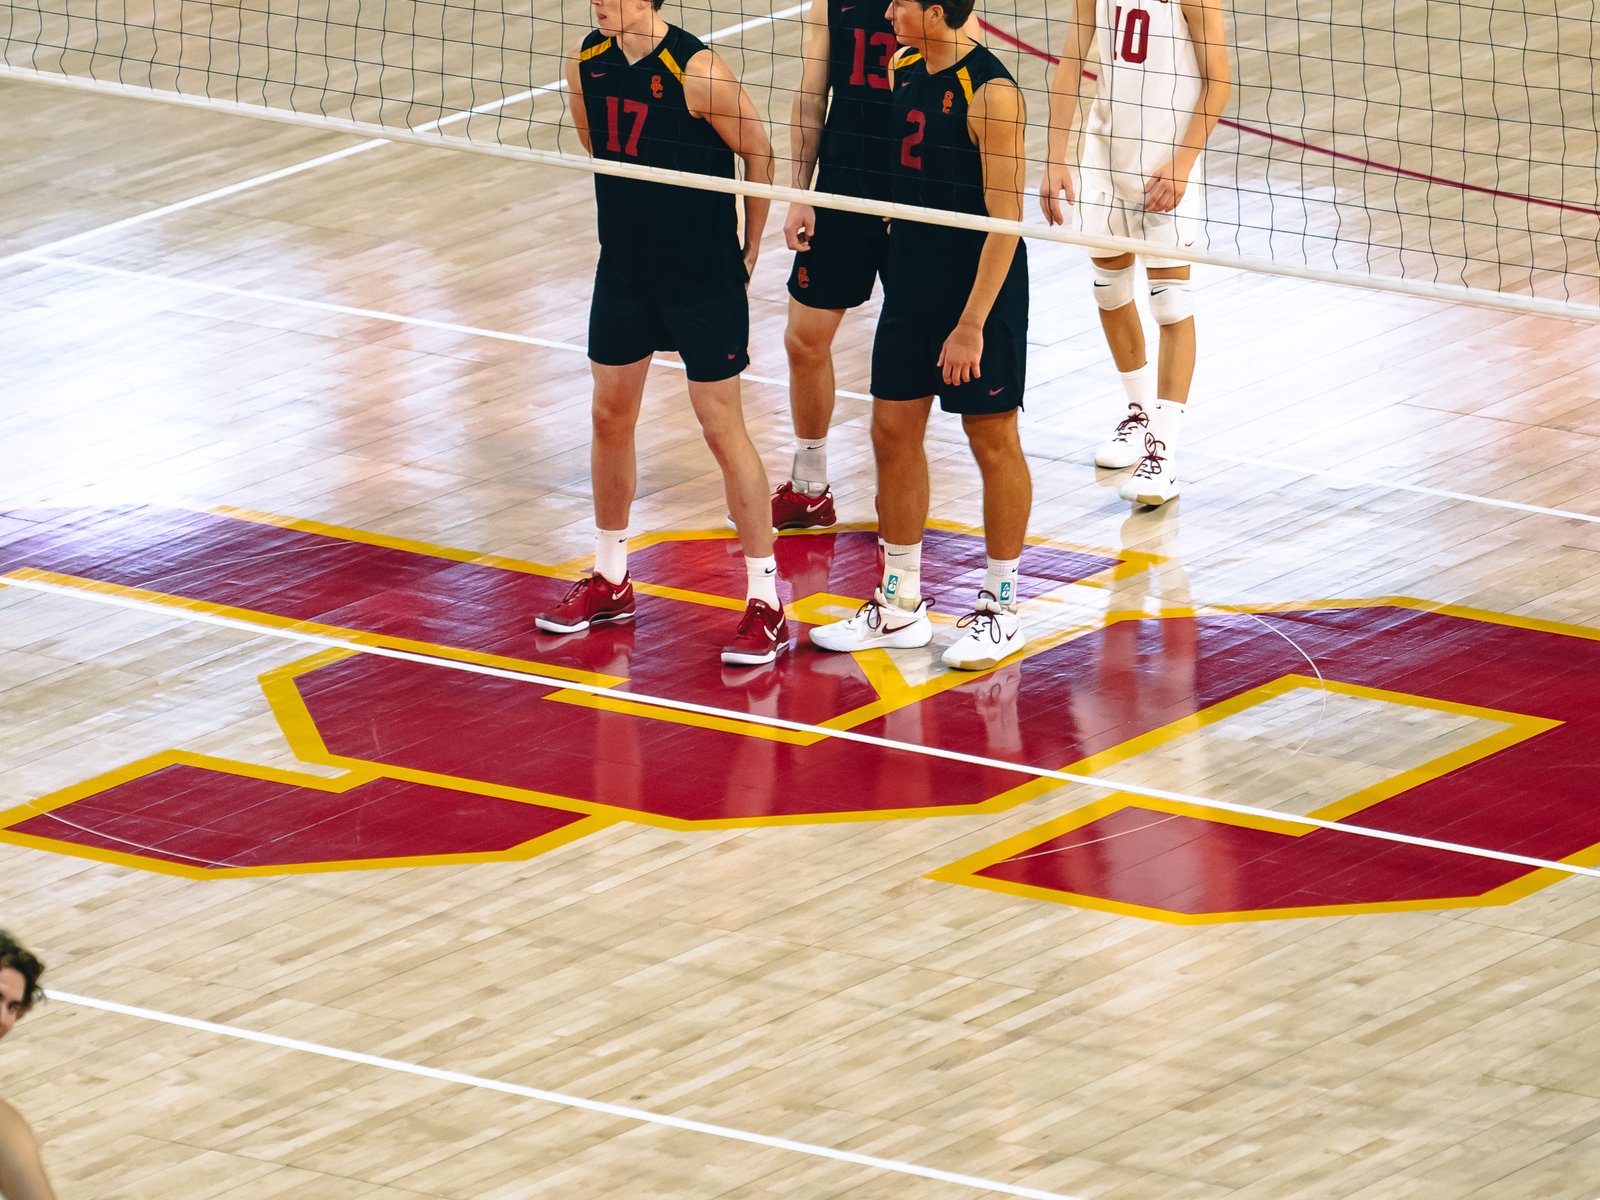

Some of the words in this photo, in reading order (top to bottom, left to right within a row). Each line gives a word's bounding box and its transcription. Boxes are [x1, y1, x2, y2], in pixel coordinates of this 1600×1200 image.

[850, 28, 897, 90] 13
[605, 96, 649, 157] 17
[901, 108, 926, 171] 2
